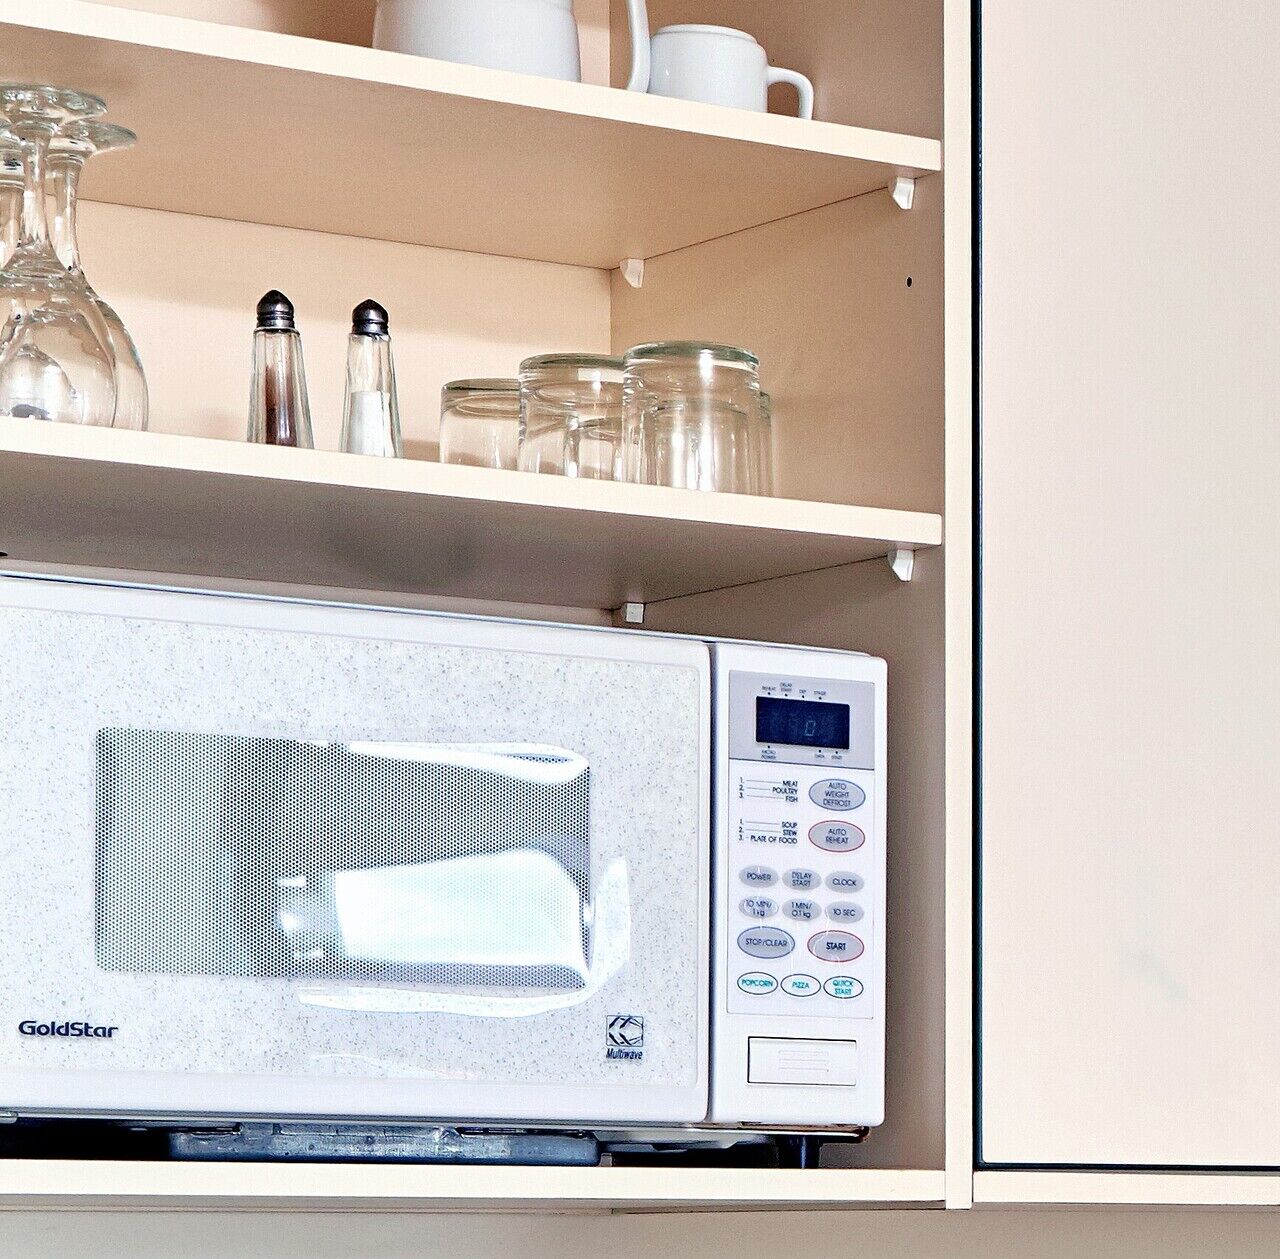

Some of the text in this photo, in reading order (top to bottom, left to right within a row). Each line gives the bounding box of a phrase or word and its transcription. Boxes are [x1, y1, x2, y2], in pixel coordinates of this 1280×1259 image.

[828, 782, 847, 790] AUTO
[772, 787, 798, 795] POULTRY
[824, 790, 850, 798] WEIGHT
[822, 798, 851, 807] DEFROST
[781, 821, 798, 829] SOUP
[828, 828, 847, 836] AUTO
[750, 835, 767, 843] PLATE
[779, 836, 798, 844] FOOD
[825, 836, 849, 844] REHEAT
[746, 872, 772, 881] POWER
[791, 871, 813, 880] DELAY
[832, 878, 857, 887] CLOCK
[842, 908, 856, 917] SEC
[745, 938, 788, 947] STOP/CLEAR
[826, 942, 847, 951] START
[741, 978, 774, 987] POPCORN
[792, 981, 810, 989] PIZZA
[832, 979, 854, 987] QUICK
[19, 1021, 118, 1038] GoldStar
[606, 1048, 643, 1060] Multiwave
